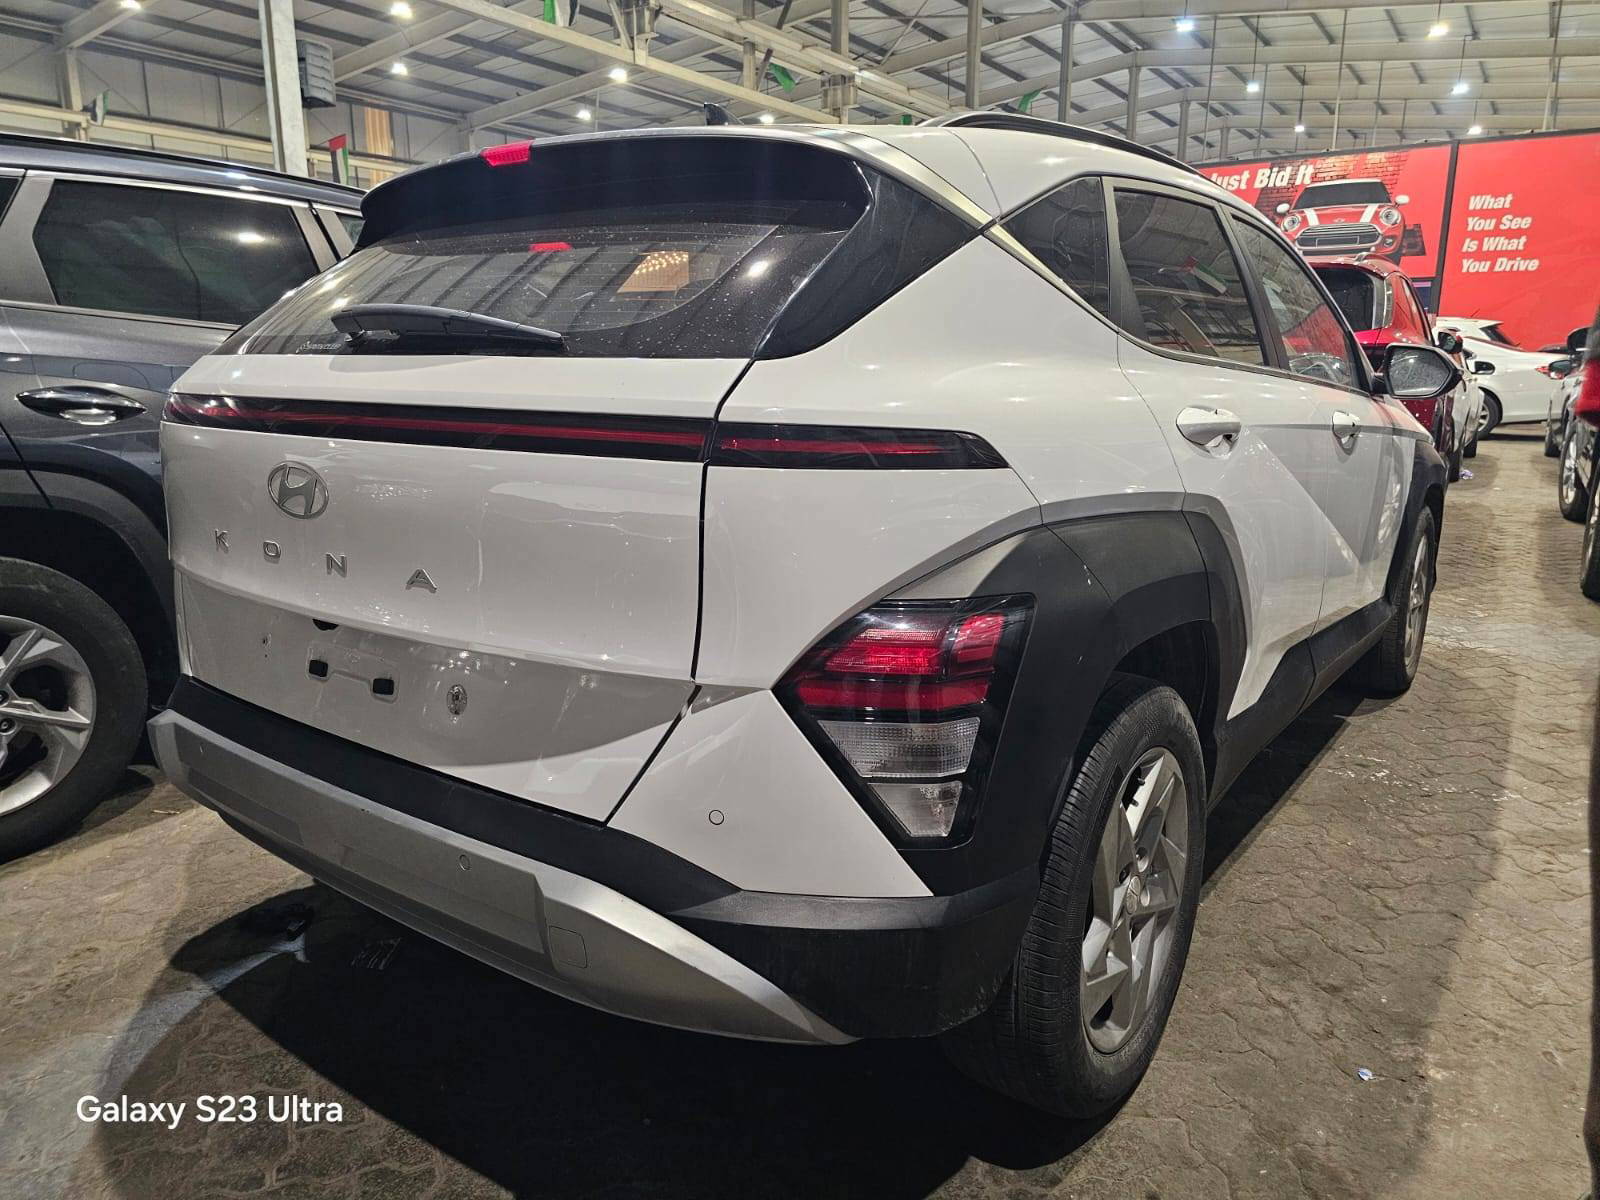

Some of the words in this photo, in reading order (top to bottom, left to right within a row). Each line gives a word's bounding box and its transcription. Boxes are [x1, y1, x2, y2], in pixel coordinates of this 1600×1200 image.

[1253, 166, 1293, 188] Bid
[1295, 164, 1314, 185] It
[1469, 193, 1513, 210] What
[1467, 216, 1497, 231] You
[1499, 214, 1532, 230] See
[1461, 238, 1479, 252] Is
[1482, 235, 1527, 251] What
[1461, 258, 1492, 272] You
[1493, 257, 1540, 272] Drive
